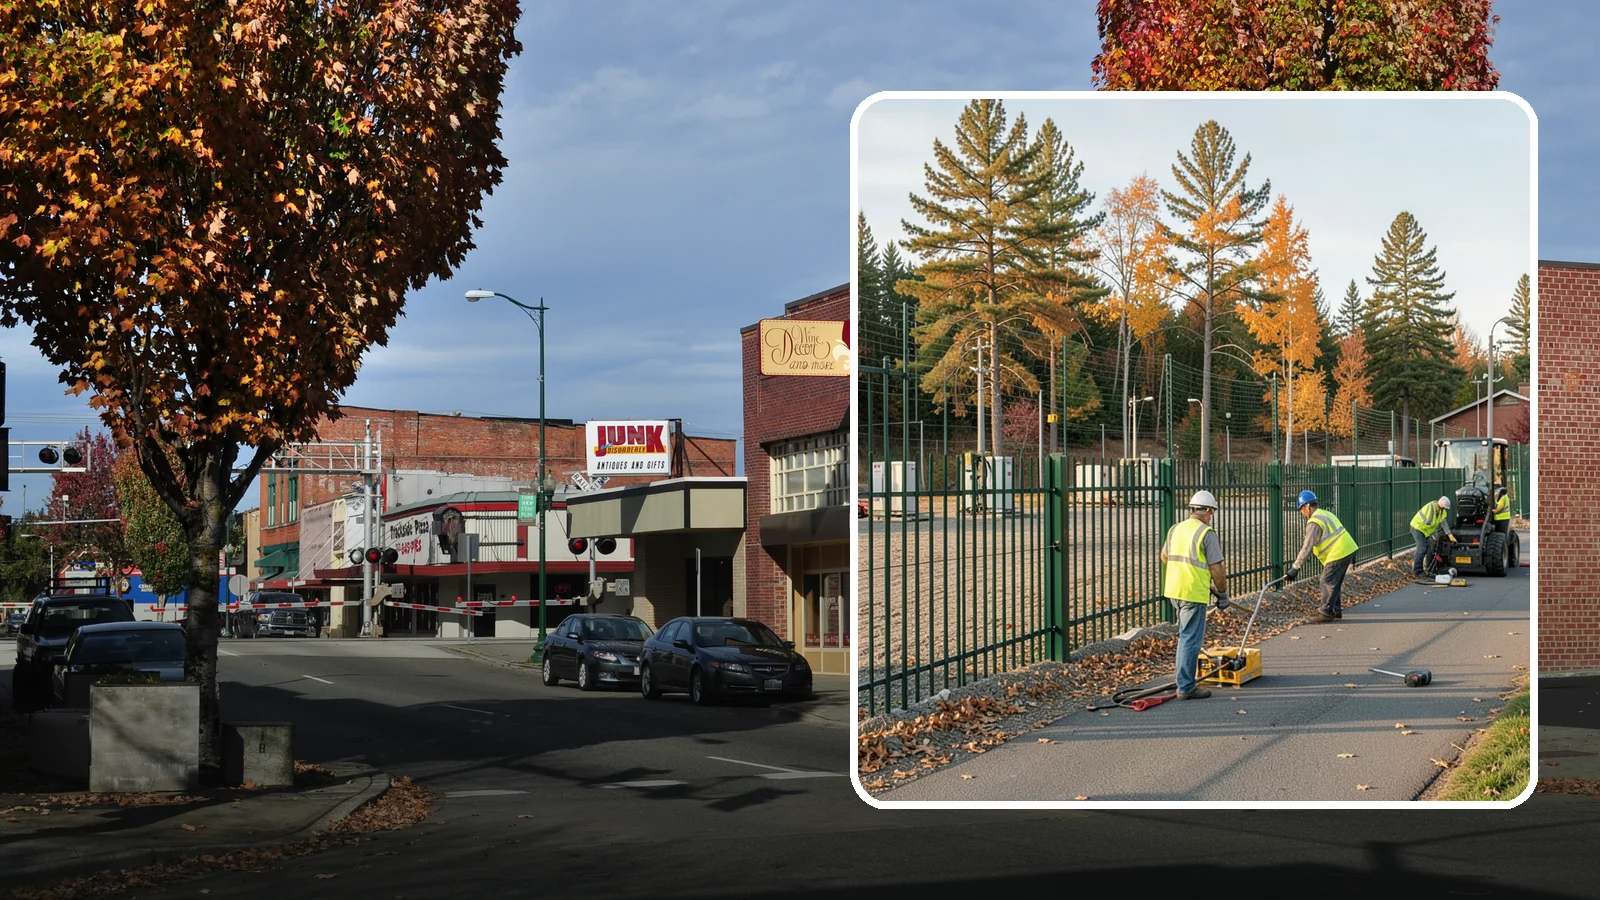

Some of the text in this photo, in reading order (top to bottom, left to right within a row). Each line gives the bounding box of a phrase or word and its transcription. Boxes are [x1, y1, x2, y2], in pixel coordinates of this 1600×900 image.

[595, 425, 664, 457] JUNK
[607, 446, 646, 454] DISORDERLY
[597, 460, 665, 470] ANTIQUES AND GIFTS
[414, 519, 429, 535] Pizza
